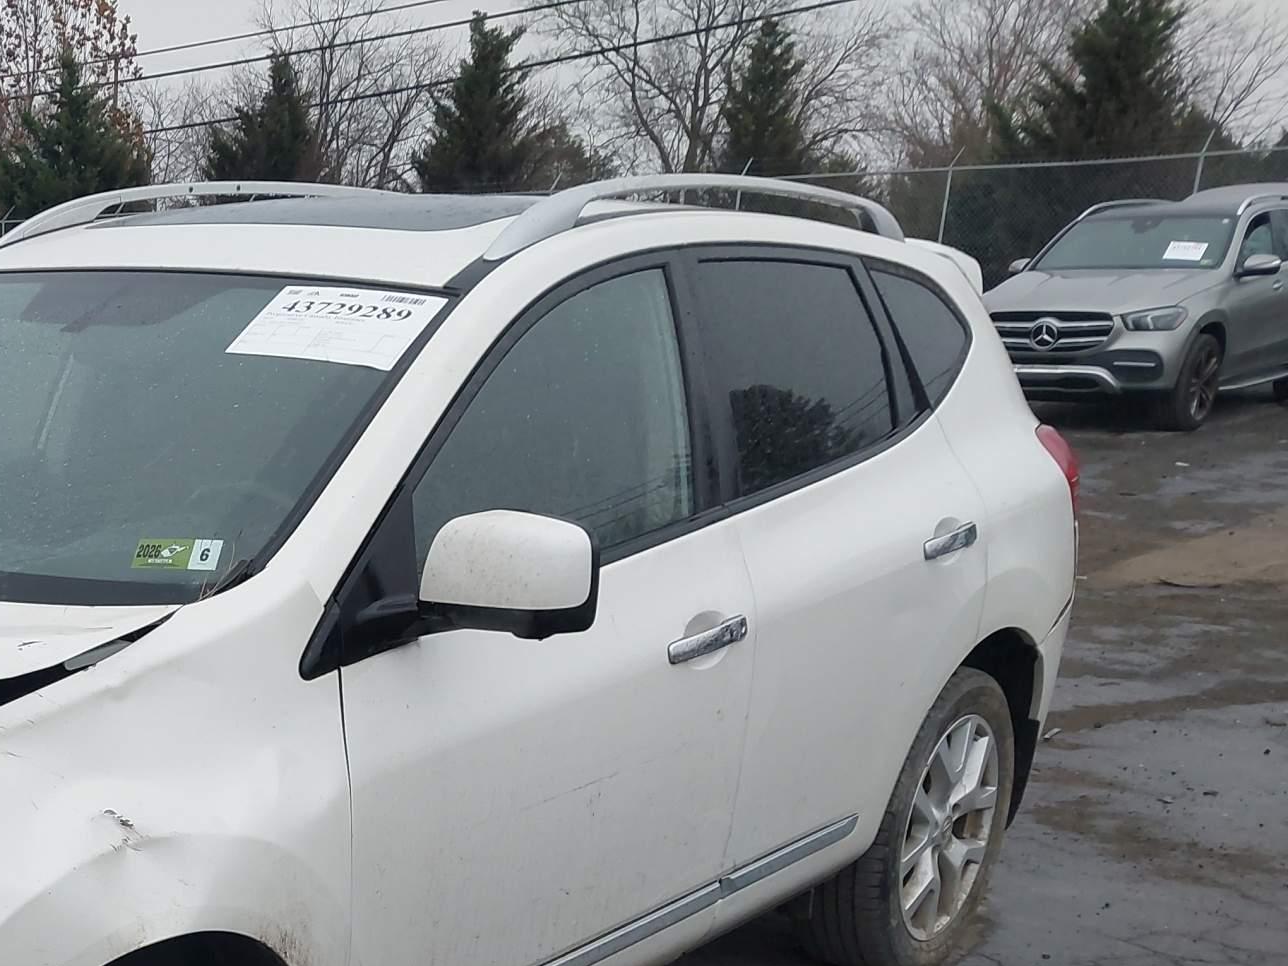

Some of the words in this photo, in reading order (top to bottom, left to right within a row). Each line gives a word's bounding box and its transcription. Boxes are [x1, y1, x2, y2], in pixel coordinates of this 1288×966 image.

[282, 299, 413, 322] 43729289
[136, 544, 162, 559] 2026
[199, 547, 211, 562] 6
